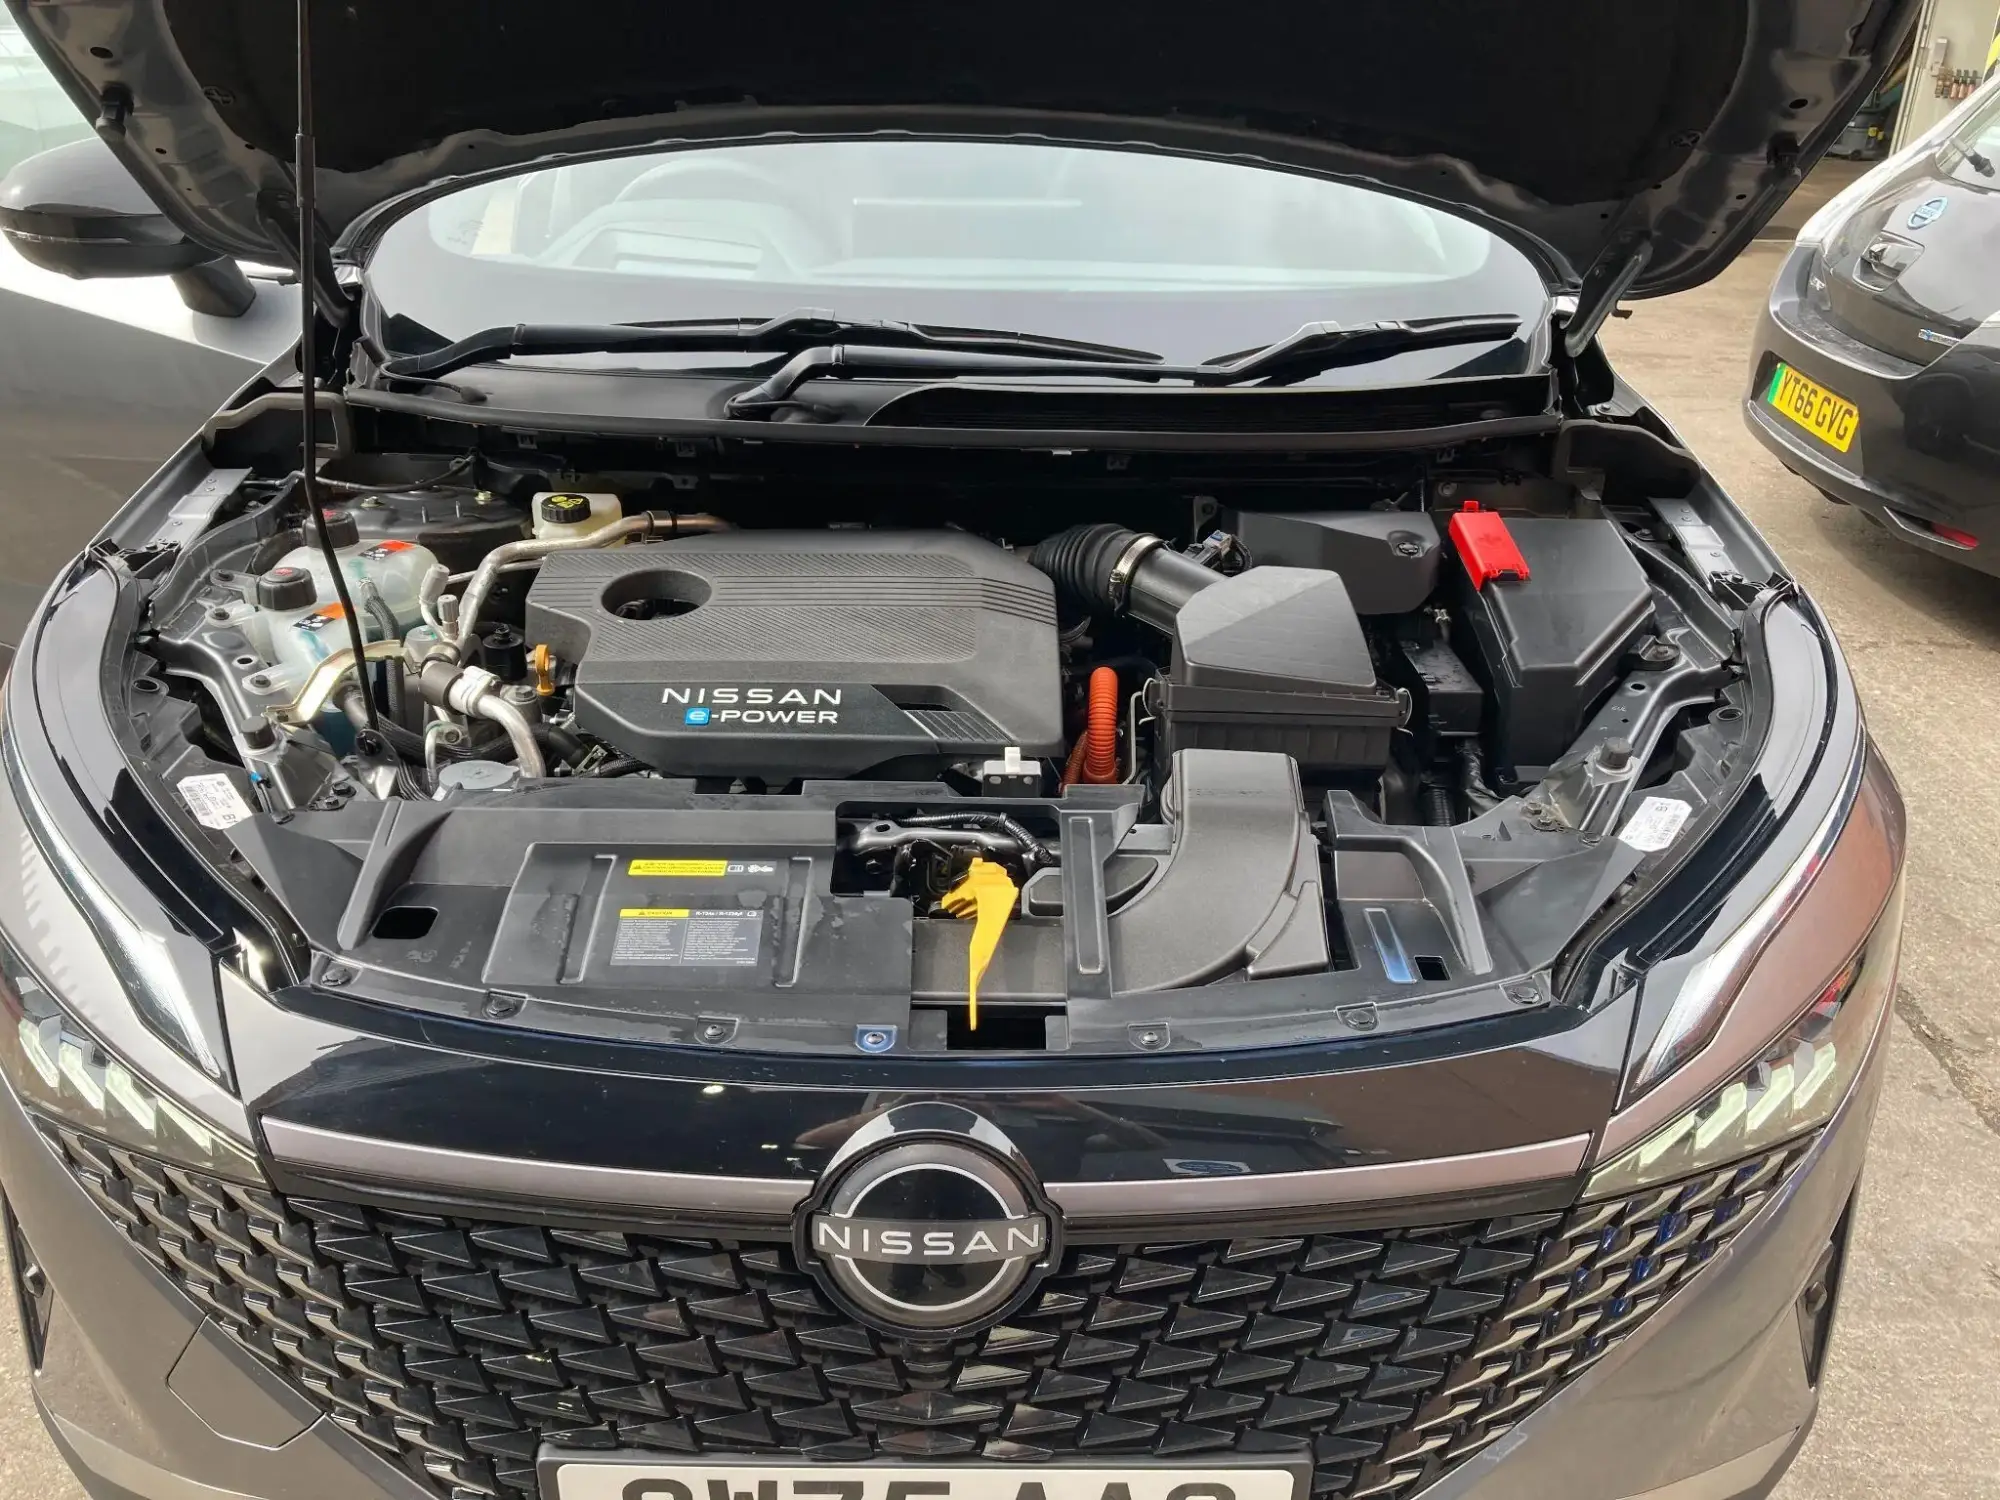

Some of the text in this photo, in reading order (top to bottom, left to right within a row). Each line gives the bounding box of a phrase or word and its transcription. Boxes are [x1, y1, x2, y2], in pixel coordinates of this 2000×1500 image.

[1780, 370, 1854, 441] YT66 GVG
[661, 687, 842, 705] NISSAN
[687, 709, 839, 724] e-POWER
[818, 1222, 1040, 1256] NISSAN
